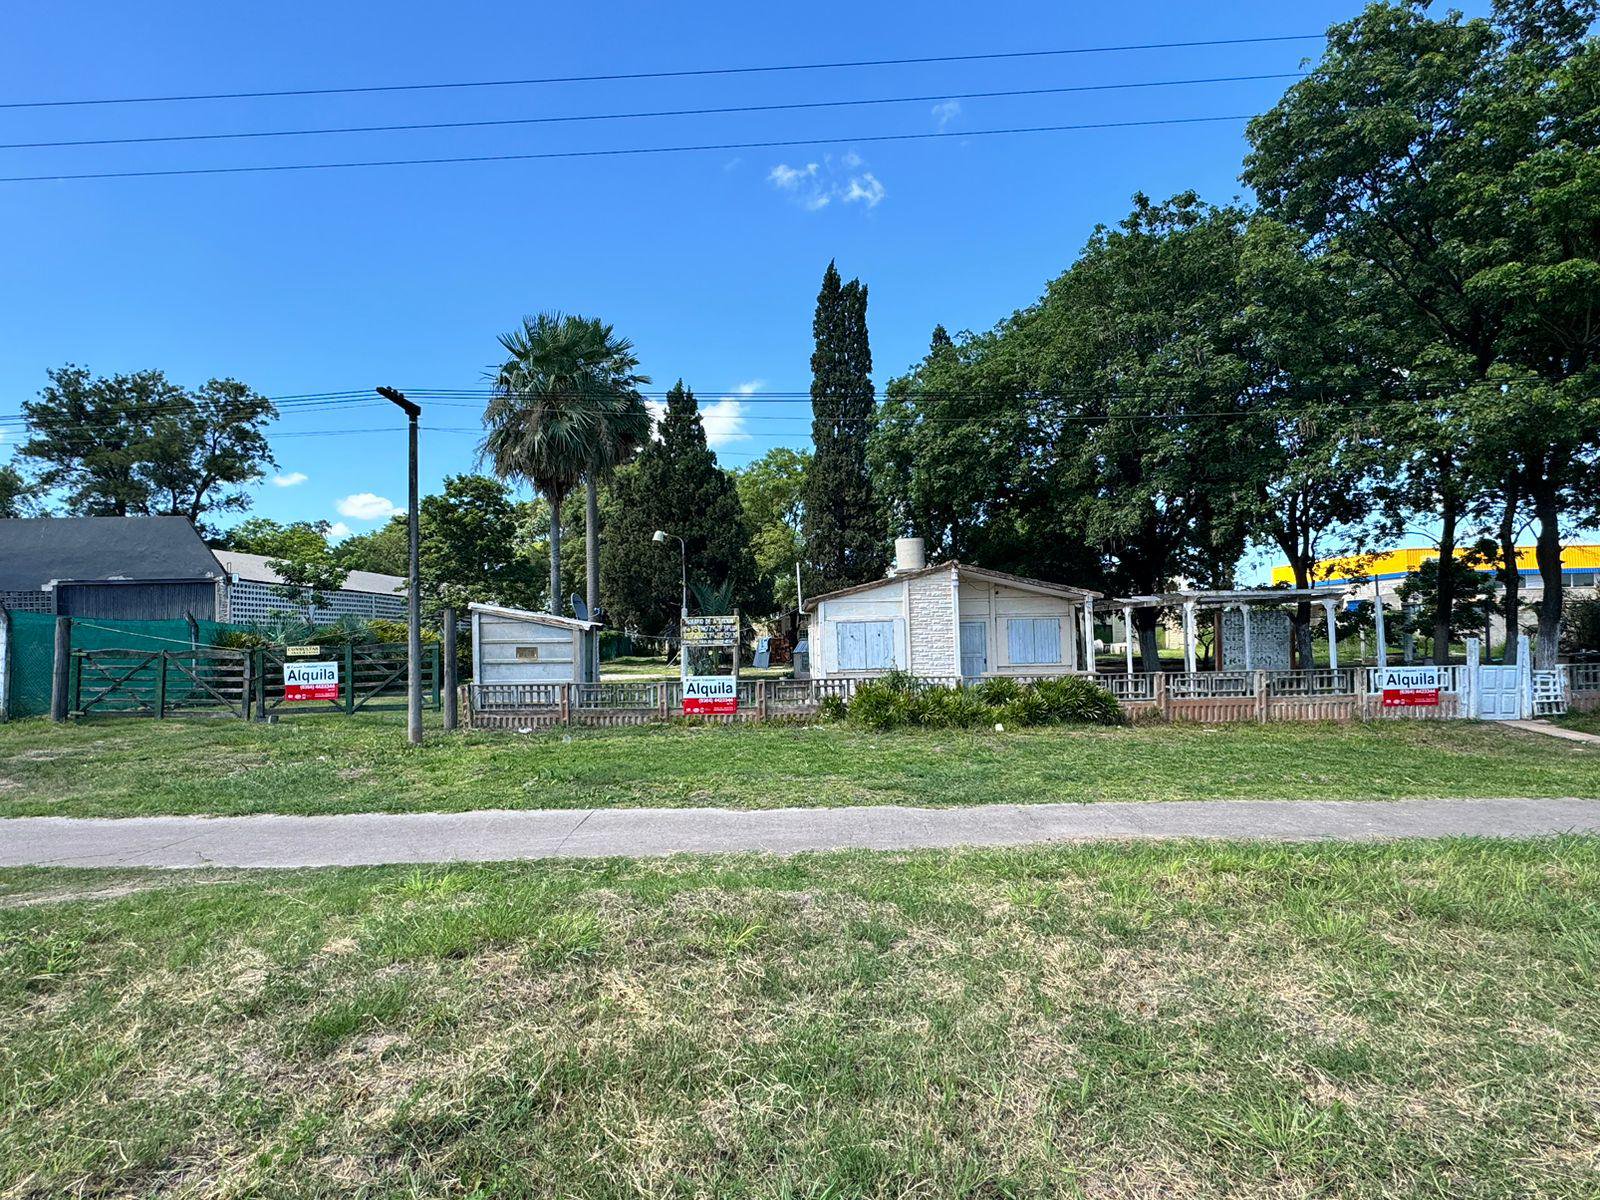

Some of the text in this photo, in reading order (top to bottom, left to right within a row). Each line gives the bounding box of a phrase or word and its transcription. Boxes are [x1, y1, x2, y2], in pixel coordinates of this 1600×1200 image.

[287, 668, 335, 684] Alquila
[1386, 672, 1435, 688] Alquila
[686, 682, 733, 697] Alquila
